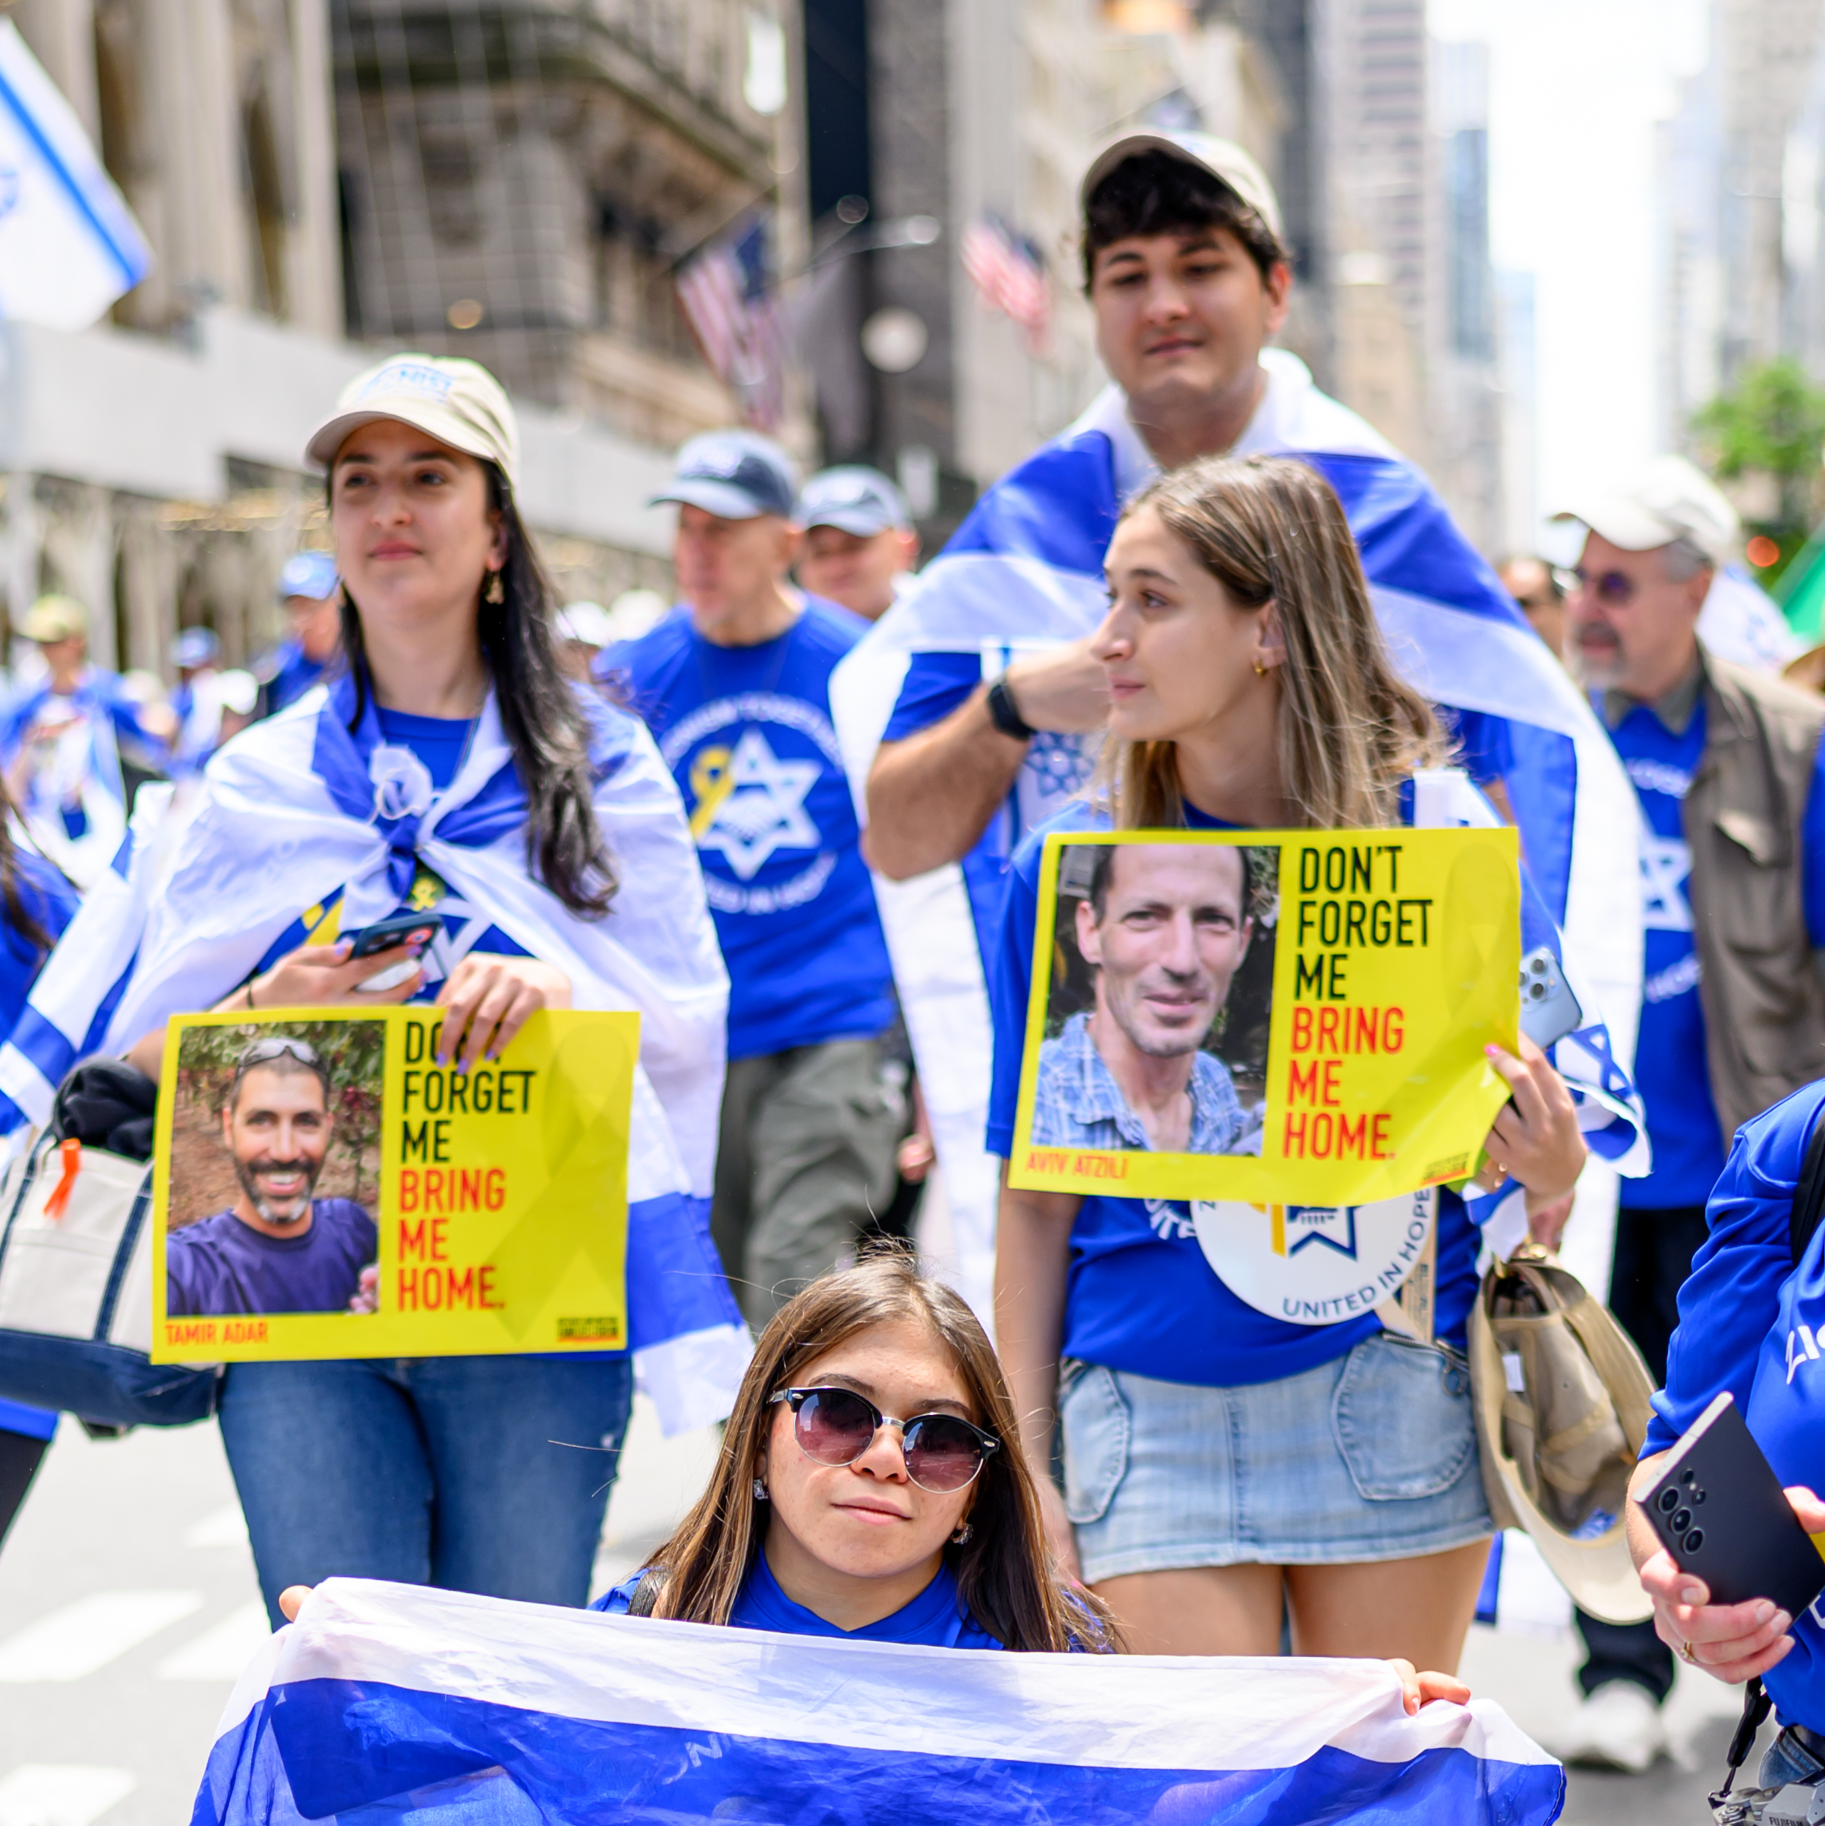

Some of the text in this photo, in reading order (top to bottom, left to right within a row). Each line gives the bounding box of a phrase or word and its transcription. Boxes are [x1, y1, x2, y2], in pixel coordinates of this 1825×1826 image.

[1300, 846, 1403, 894] DON'T
[1298, 898, 1433, 947] FORGET
[1294, 953, 1347, 1000] ME
[1291, 1006, 1404, 1054] BRING
[403, 1070, 537, 1114] FORGET
[1287, 1060, 1343, 1107] ME
[400, 1119, 453, 1163] ME
[1283, 1112, 1397, 1161] HOME.
[1025, 1152, 1070, 1176] AVIV
[399, 1168, 507, 1213] BRING
[397, 1218, 449, 1262] ME
[1282, 1187, 1431, 1318] UNITED IN HOPE
[397, 1266, 506, 1312] HOME.
[165, 1322, 269, 1347] TAMIR ADAR
